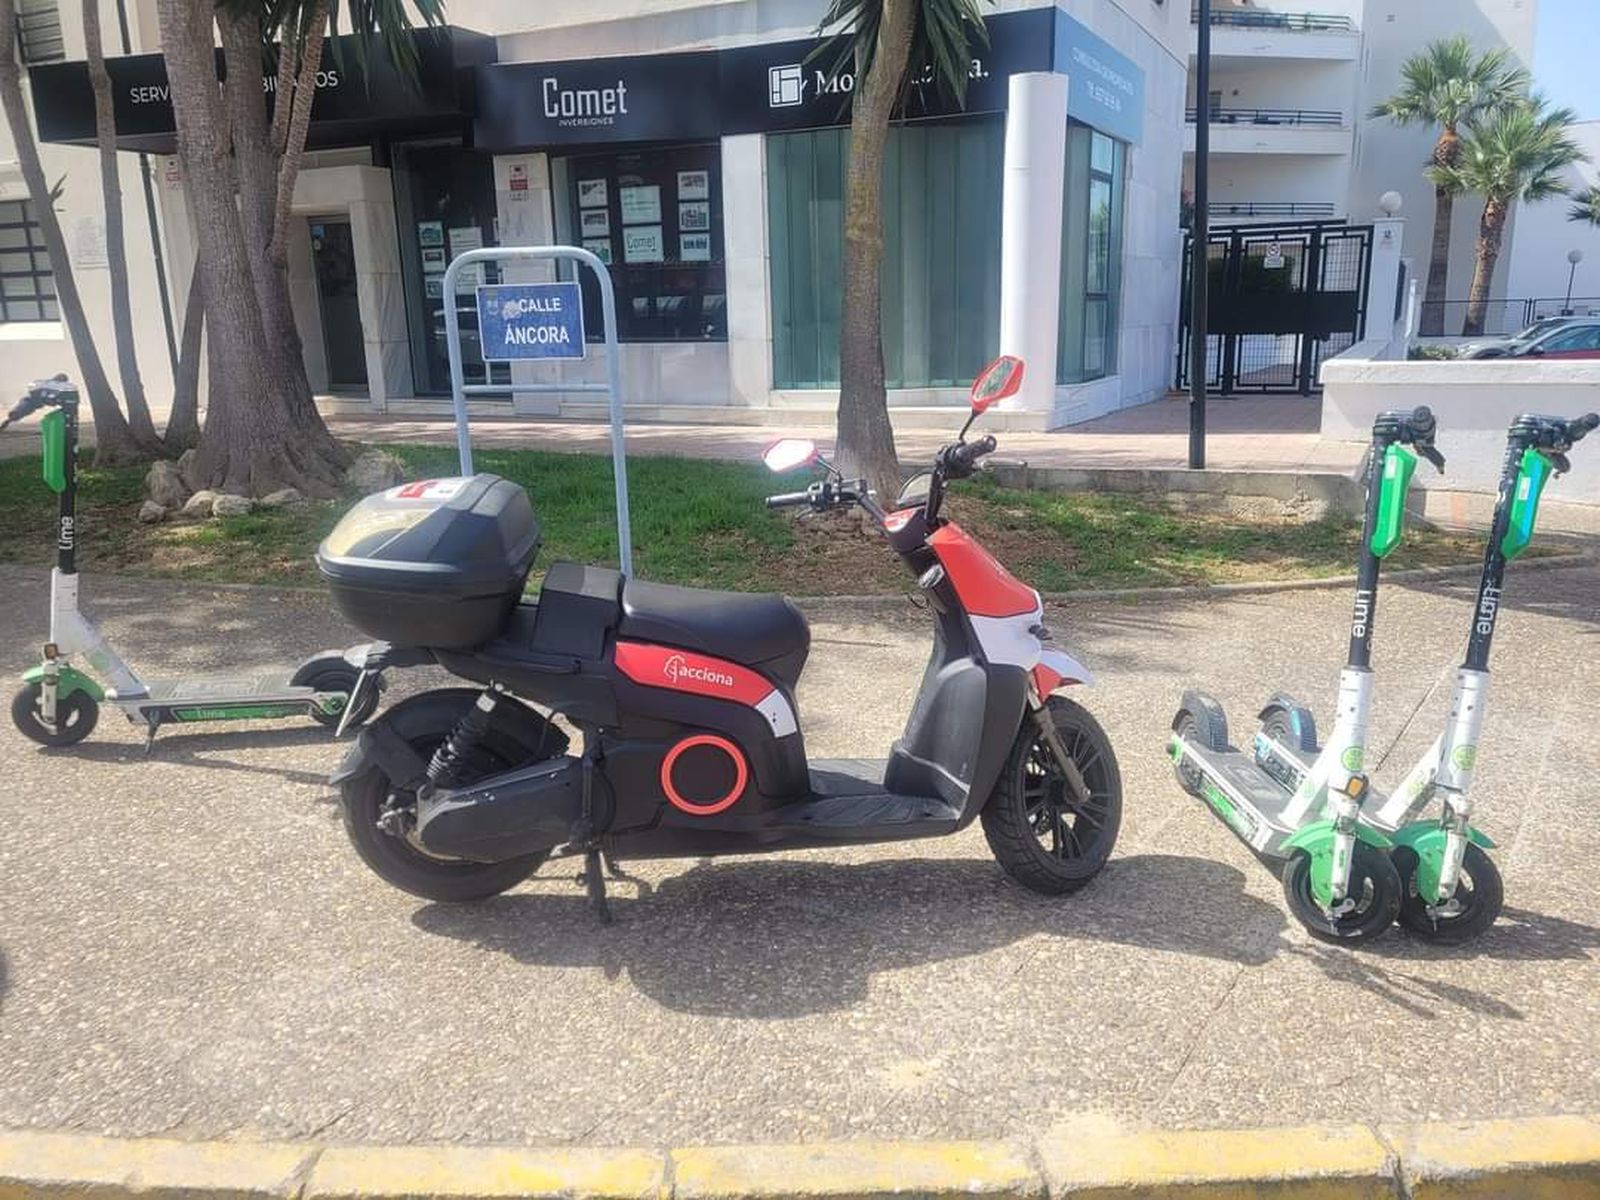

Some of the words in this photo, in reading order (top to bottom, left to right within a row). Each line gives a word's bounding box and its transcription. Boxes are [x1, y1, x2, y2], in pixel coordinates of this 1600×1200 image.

[543, 78, 628, 117] Comet
[519, 297, 562, 313] CALLE
[504, 323, 570, 345] ÁNCORA
[679, 665, 733, 686] acciona
